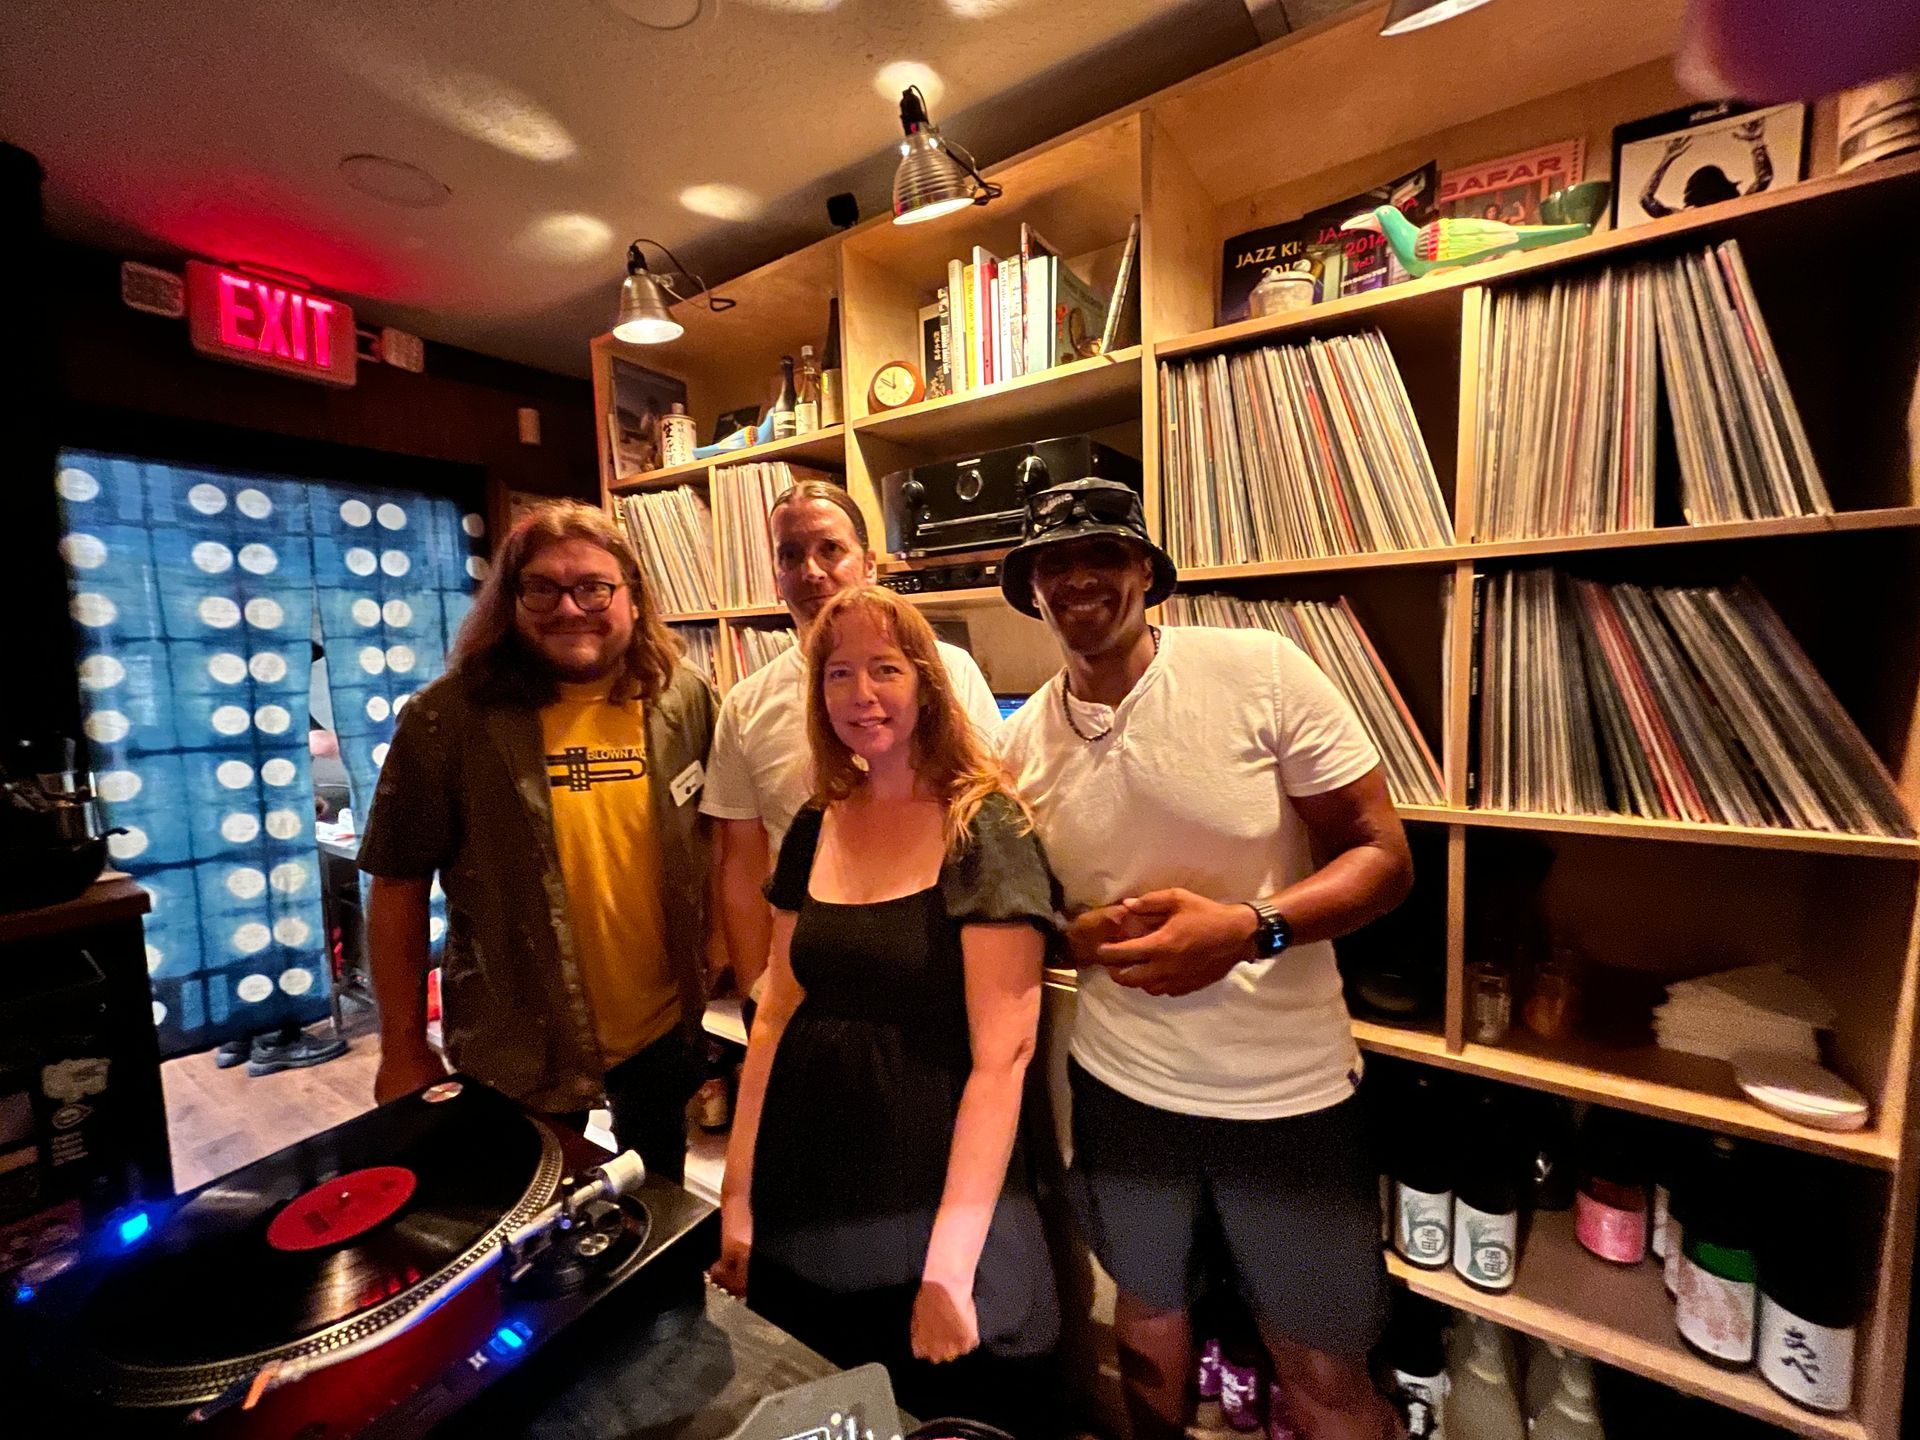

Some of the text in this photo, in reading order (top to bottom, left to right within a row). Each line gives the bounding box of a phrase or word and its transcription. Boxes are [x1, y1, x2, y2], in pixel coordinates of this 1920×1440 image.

[1440, 156, 1561, 198] SAFAR
[1235, 246, 1276, 269] JAZZ
[1344, 233, 1387, 258] 2014
[219, 272, 334, 369] EXIT
